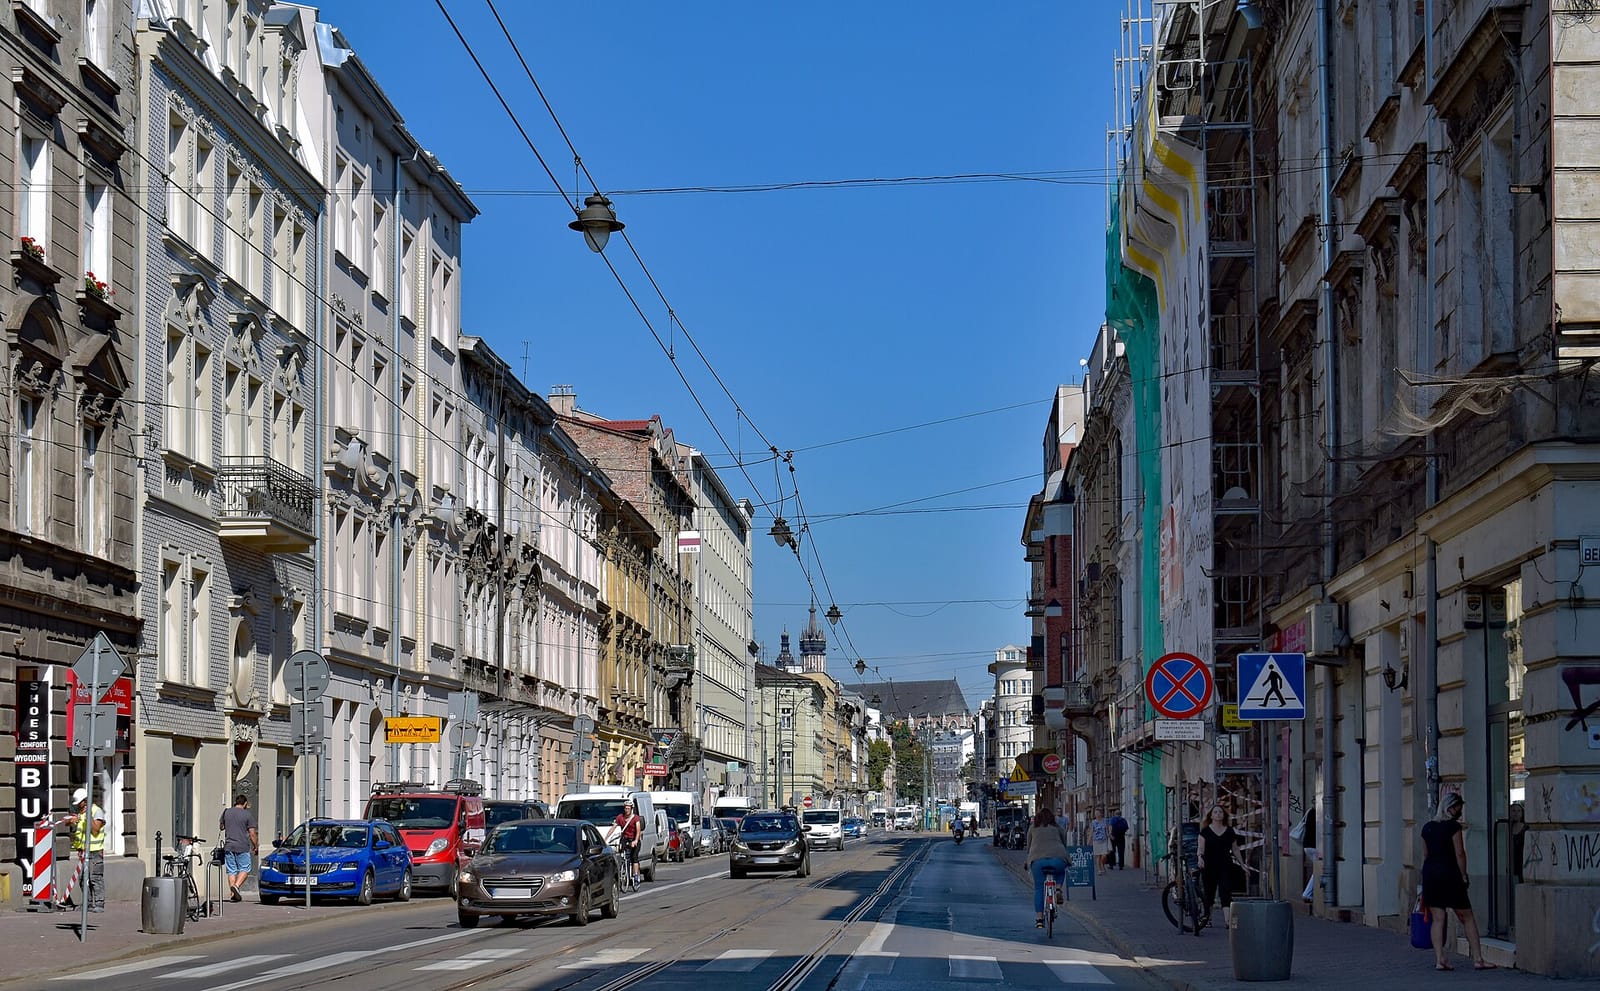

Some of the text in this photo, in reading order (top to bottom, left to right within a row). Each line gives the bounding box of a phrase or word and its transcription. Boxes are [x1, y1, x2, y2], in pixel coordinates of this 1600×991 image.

[1584, 548, 1600, 560] BE
[29, 682, 39, 740] SHOES
[14, 754, 47, 762] WYGODNE
[22, 883, 32, 892] GO
